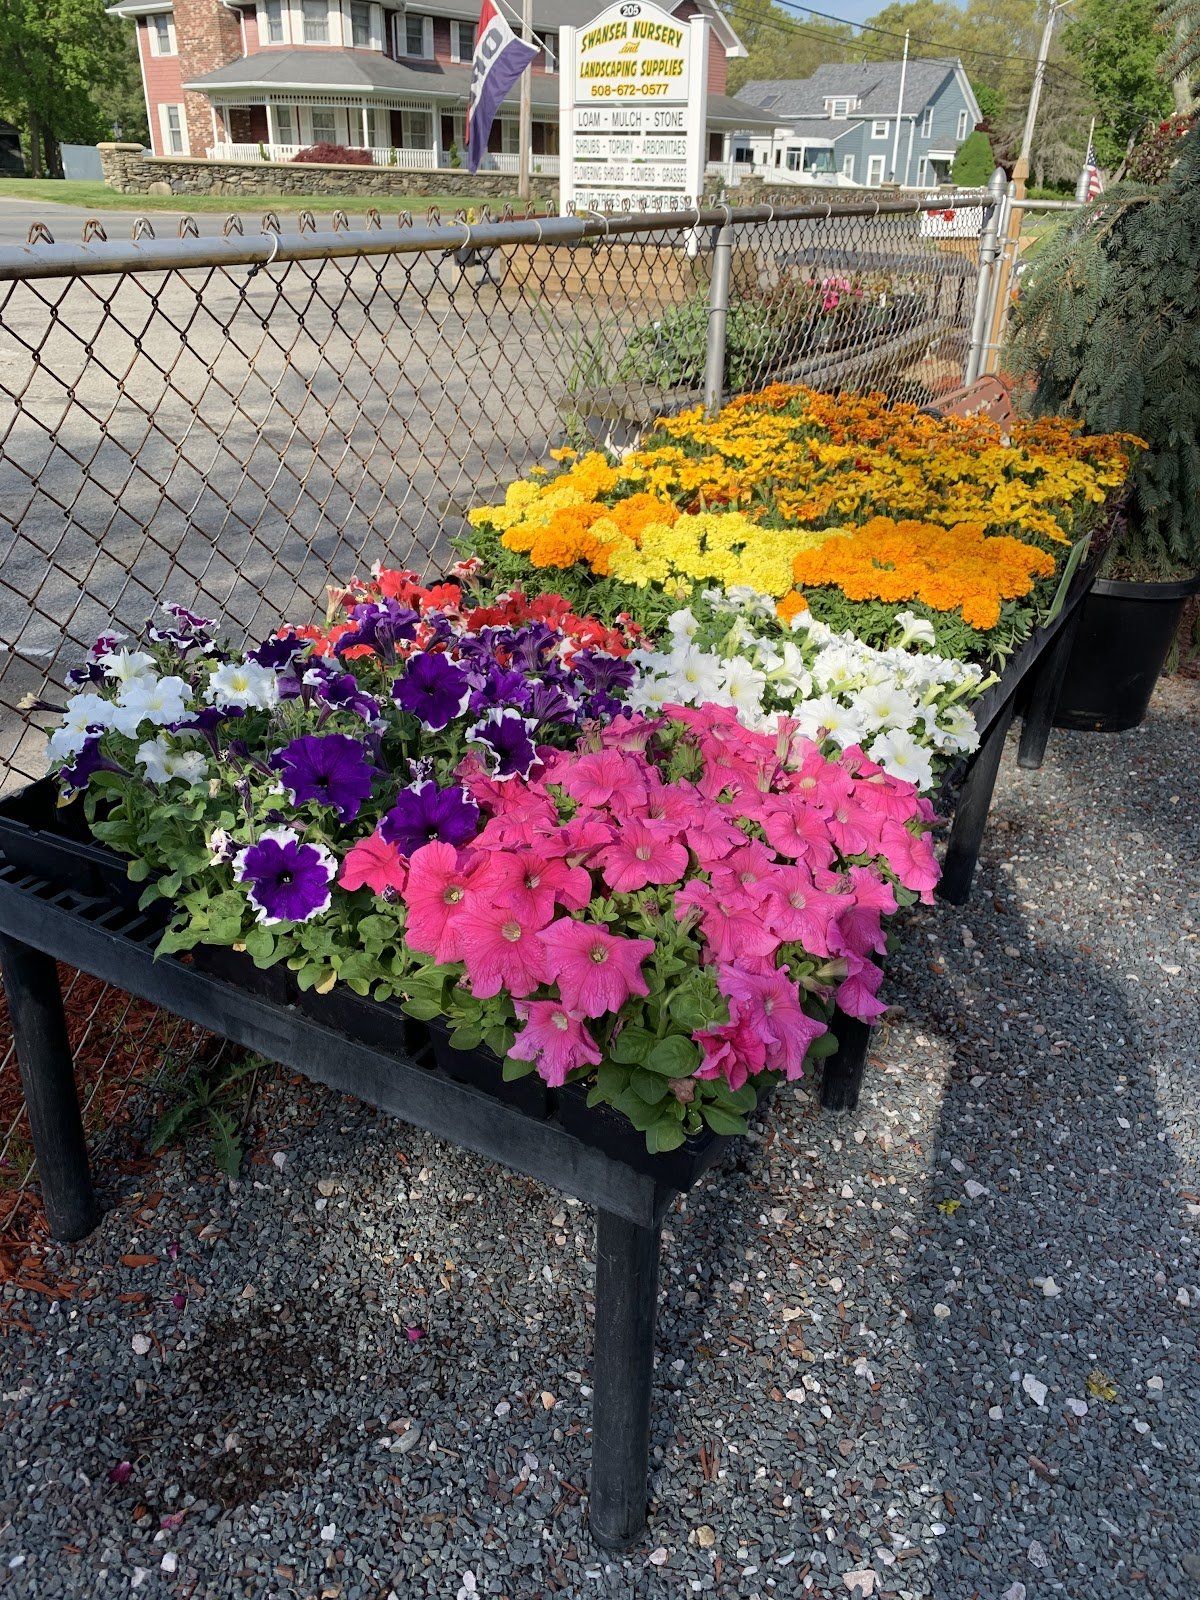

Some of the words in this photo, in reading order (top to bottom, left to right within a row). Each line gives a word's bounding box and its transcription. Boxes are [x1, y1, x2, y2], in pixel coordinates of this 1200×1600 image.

[622, 5, 639, 15] 205
[581, 21, 627, 53] SWANSEA
[633, 20, 683, 48] NURSERY
[580, 60, 637, 78] LANDSCAPING
[640, 59, 684, 76] SUPPLIES
[591, 84, 669, 97] 508-672-0577
[578, 112, 600, 127] LOAM
[612, 111, 642, 127] MULCH
[654, 111, 684, 127] STONE
[575, 139, 600, 154] SHRUBS
[643, 139, 687, 155] ARBORVITAES
